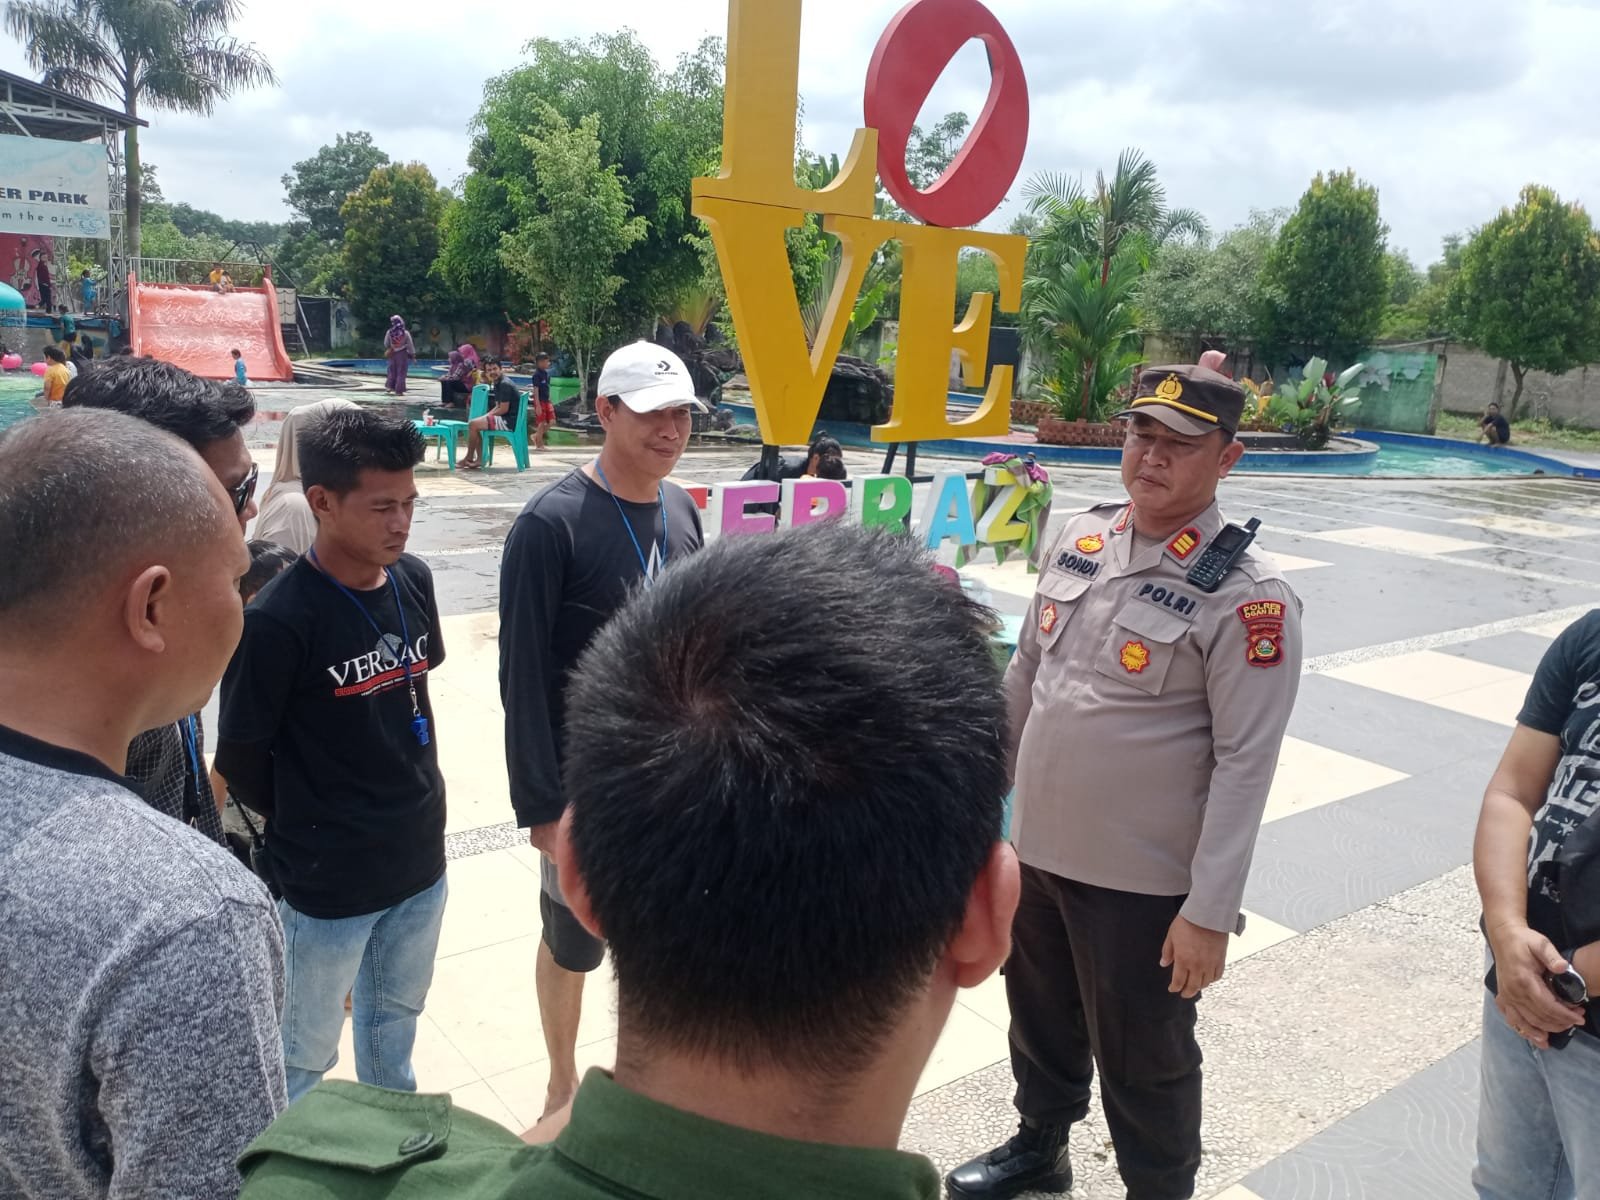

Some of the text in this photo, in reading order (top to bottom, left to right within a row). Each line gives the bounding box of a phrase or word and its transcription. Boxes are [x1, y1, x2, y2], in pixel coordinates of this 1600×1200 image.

[28, 189, 89, 206] PARK
[19, 210, 44, 222] the
[51, 215, 73, 223] air
[1057, 551, 1100, 577] SONDI
[1139, 583, 1196, 616] POLRI
[1243, 602, 1281, 614] POLRES
